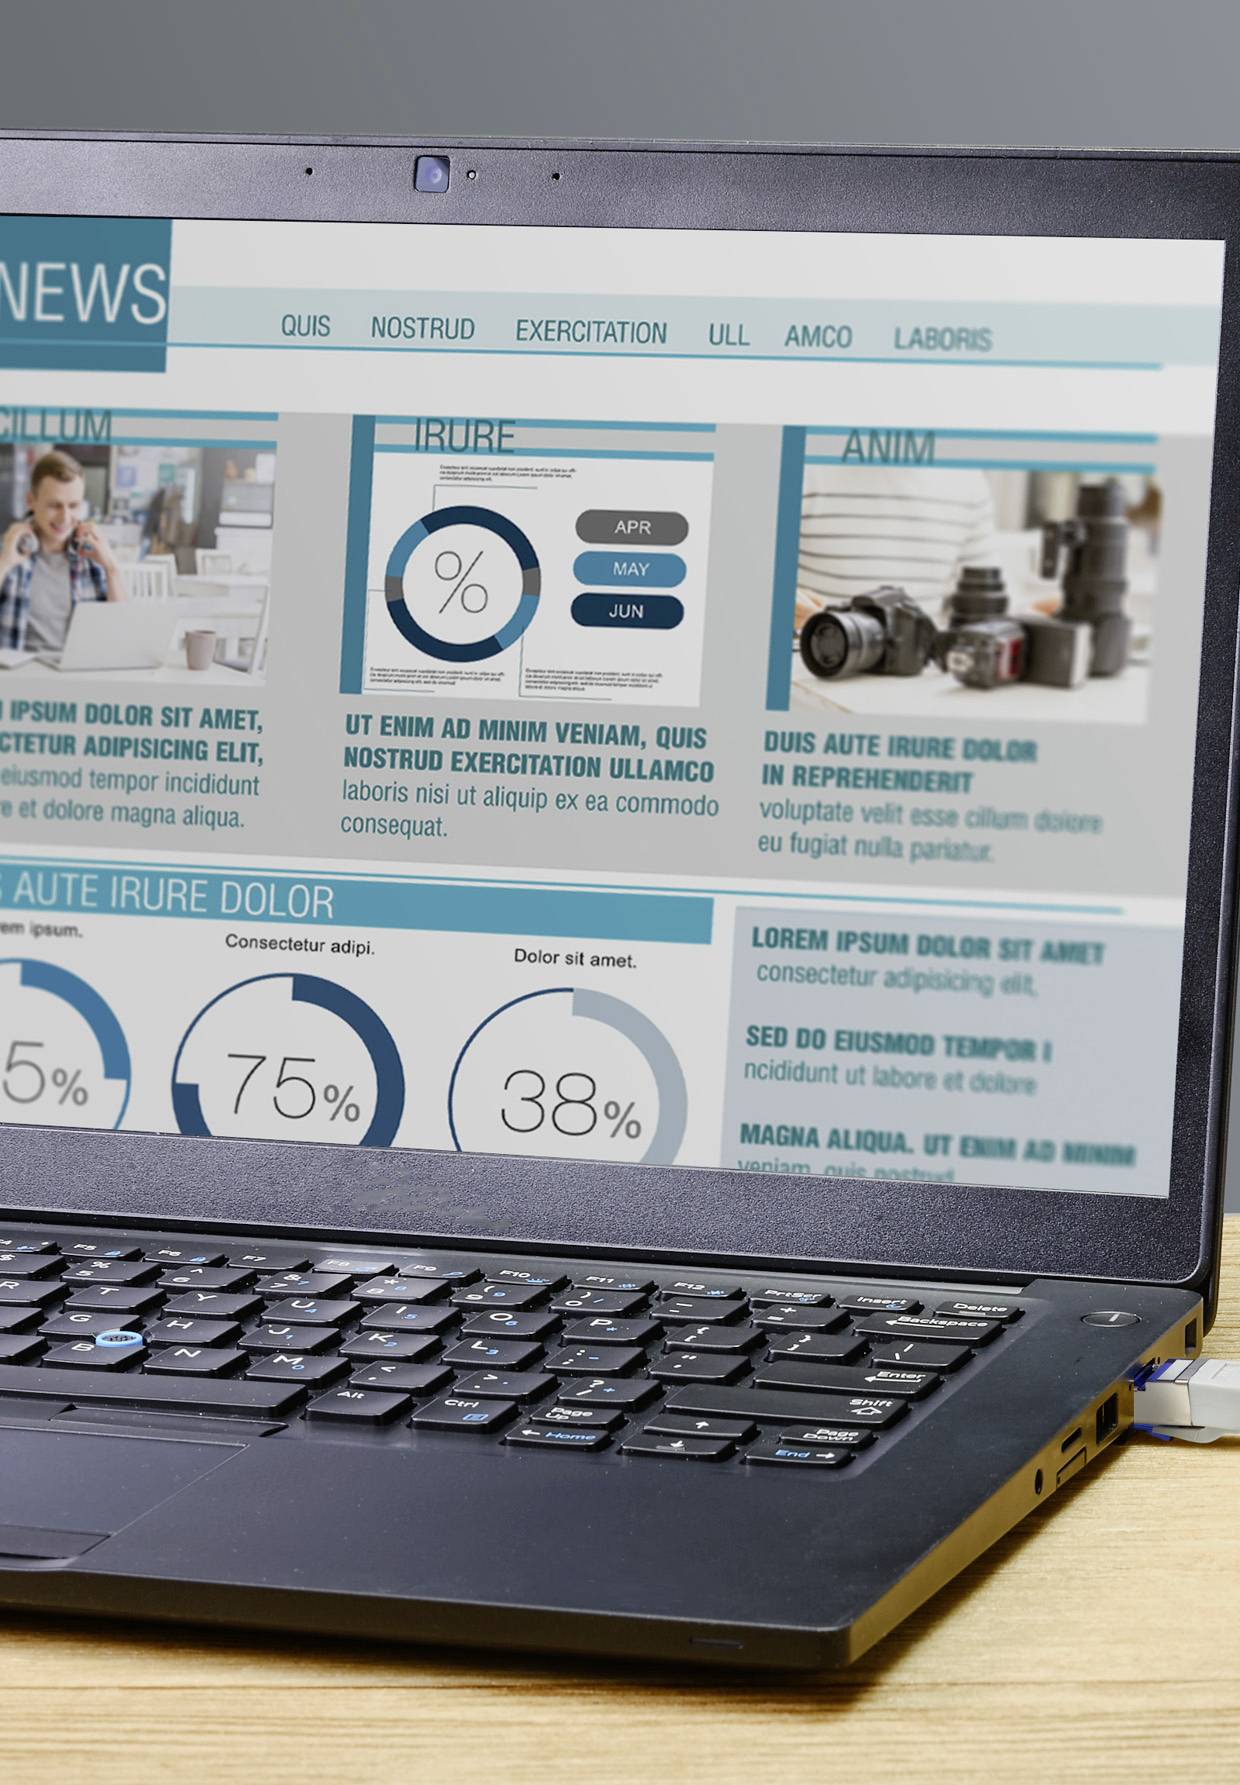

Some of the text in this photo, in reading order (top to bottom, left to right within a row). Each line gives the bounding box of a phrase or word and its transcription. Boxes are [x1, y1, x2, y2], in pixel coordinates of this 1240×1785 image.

[0, 261, 167, 325] NEWS
[281, 314, 993, 352] QUIS NOSTRUD EXERCITATION ULL AMCO LABORIS
[0, 406, 112, 443] CILLUM
[414, 417, 516, 454] IRURE
[841, 428, 936, 465] ANIM
[614, 520, 652, 535] APR
[613, 561, 650, 577] MAY
[608, 603, 644, 619] JUN
[9, 699, 77, 724] IPSUM
[84, 703, 154, 727] DOLOR
[160, 706, 194, 729] SIT
[199, 708, 264, 735] AMET,
[345, 714, 708, 751] UT ENIM AD MINIM VENIAM, QUIS
[83, 735, 209, 762] ADIPISICING
[216, 741, 265, 767] ELIT,
[764, 730, 1039, 764] DUIS AUTE IRURE DOLOR
[343, 747, 715, 784] NOSTRUD EXERCITATION ULLAMCO
[1, 765, 260, 797] eiusmod tempor incididunt
[762, 764, 975, 796] IN REPREHENDERIT
[342, 780, 719, 818] laboris nisi ut aliquip ex ea commodo
[18, 799, 37, 818] et
[43, 799, 104, 822] dolore
[111, 804, 176, 828] magna
[182, 805, 246, 831] aliqua.
[760, 799, 854, 827] voluptate
[860, 801, 903, 825] velit
[911, 807, 959, 829] esse
[341, 814, 448, 841] consequat.
[758, 834, 783, 854] eu
[789, 831, 848, 860] fugiat
[854, 835, 904, 858] nulla
[13, 871, 335, 920] AUTE IRURE DOLOR
[30, 920, 84, 940] ipsum.
[225, 933, 376, 957] Consectetur adipi.
[752, 926, 1106, 965] LOREM IPSUM DOLOR SIT AMET
[514, 948, 638, 969] Dolor sit amet.
[756, 963, 877, 988] consectetur
[883, 967, 994, 998] adipisicing
[746, 1025, 788, 1049] SED
[795, 1027, 826, 1051] DO
[833, 1030, 936, 1057] EIUSMOD
[943, 1035, 1037, 1061] TEMPOR
[744, 1059, 838, 1085] ncididunt
[845, 1063, 868, 1086] ut
[872, 1064, 937, 1090] labore
[943, 1069, 966, 1092] et
[226, 1052, 361, 1123] 75%
[500, 1068, 643, 1140] 38%
[739, 1122, 819, 1149] MAGNA
[826, 1128, 914, 1156] ALIQUA.
[923, 1133, 951, 1158] UT
[74, 1243, 97, 1251] F5
[158, 1249, 182, 1257] F6
[499, 1269, 531, 1278] F10
[585, 1275, 615, 1284] F11
[100, 1287, 119, 1295] T
[674, 1281, 705, 1290] F12
[197, 1293, 217, 1301] Y
[291, 1300, 315, 1309] U
[856, 1296, 908, 1306] Insert
[953, 1302, 1008, 1312] Delete
[69, 1314, 92, 1322] G
[166, 1320, 193, 1330] H
[589, 1318, 613, 1326] P
[897, 1316, 989, 1330] Backspace
[269, 1327, 290, 1335] J
[368, 1333, 394, 1342] K
[71, 1343, 95, 1352] B
[174, 1349, 202, 1357] N
[470, 1340, 489, 1351] L
[273, 1355, 303, 1365] M
[876, 1371, 927, 1380] Enter
[337, 1390, 365, 1399] Alt
[444, 1399, 480, 1408] Ctrl
[849, 1399, 893, 1407] Shift
[545, 1412, 569, 1421] Up
[550, 1407, 593, 1418] Page
[545, 1431, 596, 1440] Home
[802, 1433, 853, 1441] Down
[816, 1428, 859, 1437] Page
[775, 1449, 811, 1458] End
